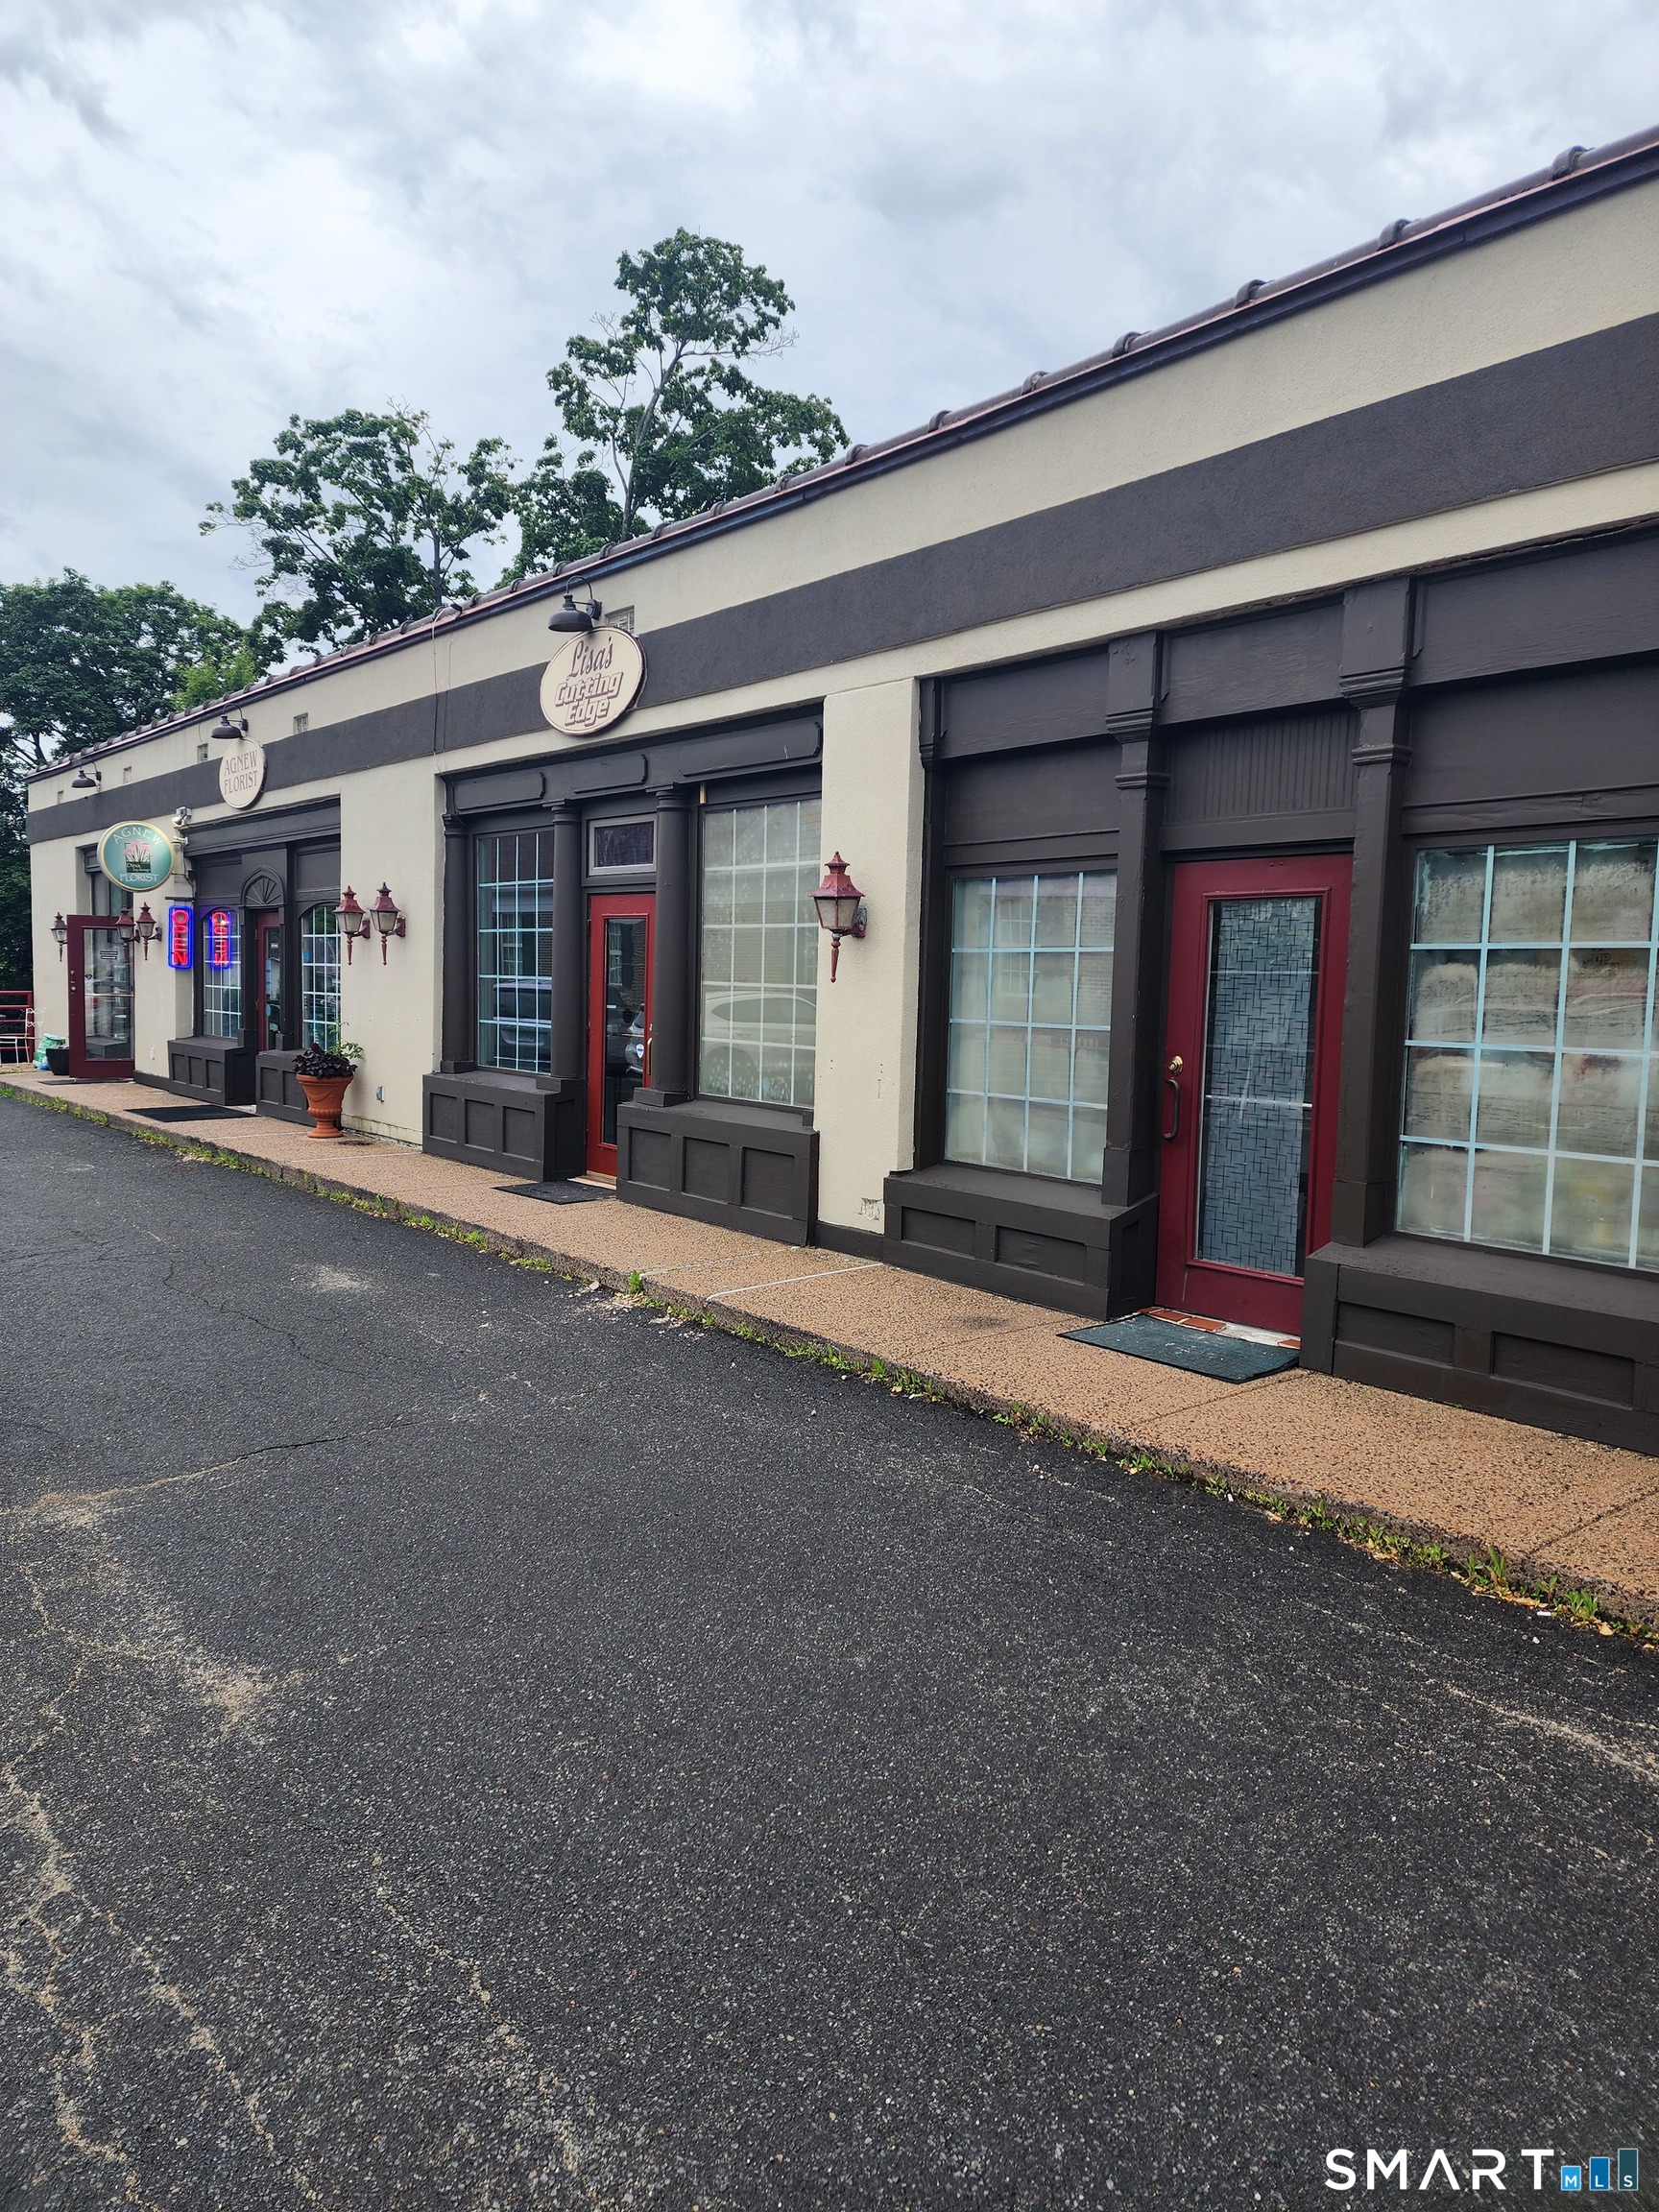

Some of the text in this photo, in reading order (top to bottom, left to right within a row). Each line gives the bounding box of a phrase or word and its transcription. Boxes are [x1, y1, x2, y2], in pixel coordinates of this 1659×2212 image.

[565, 636, 613, 681] Lisa's
[554, 671, 624, 708] Cutting
[565, 698, 610, 728] Edge
[224, 750, 257, 776] AGNEW
[224, 771, 257, 795] FLORIST
[113, 827, 163, 844] AGNEW
[119, 873, 159, 882] FLORIST
[172, 909, 189, 966] OPEN
